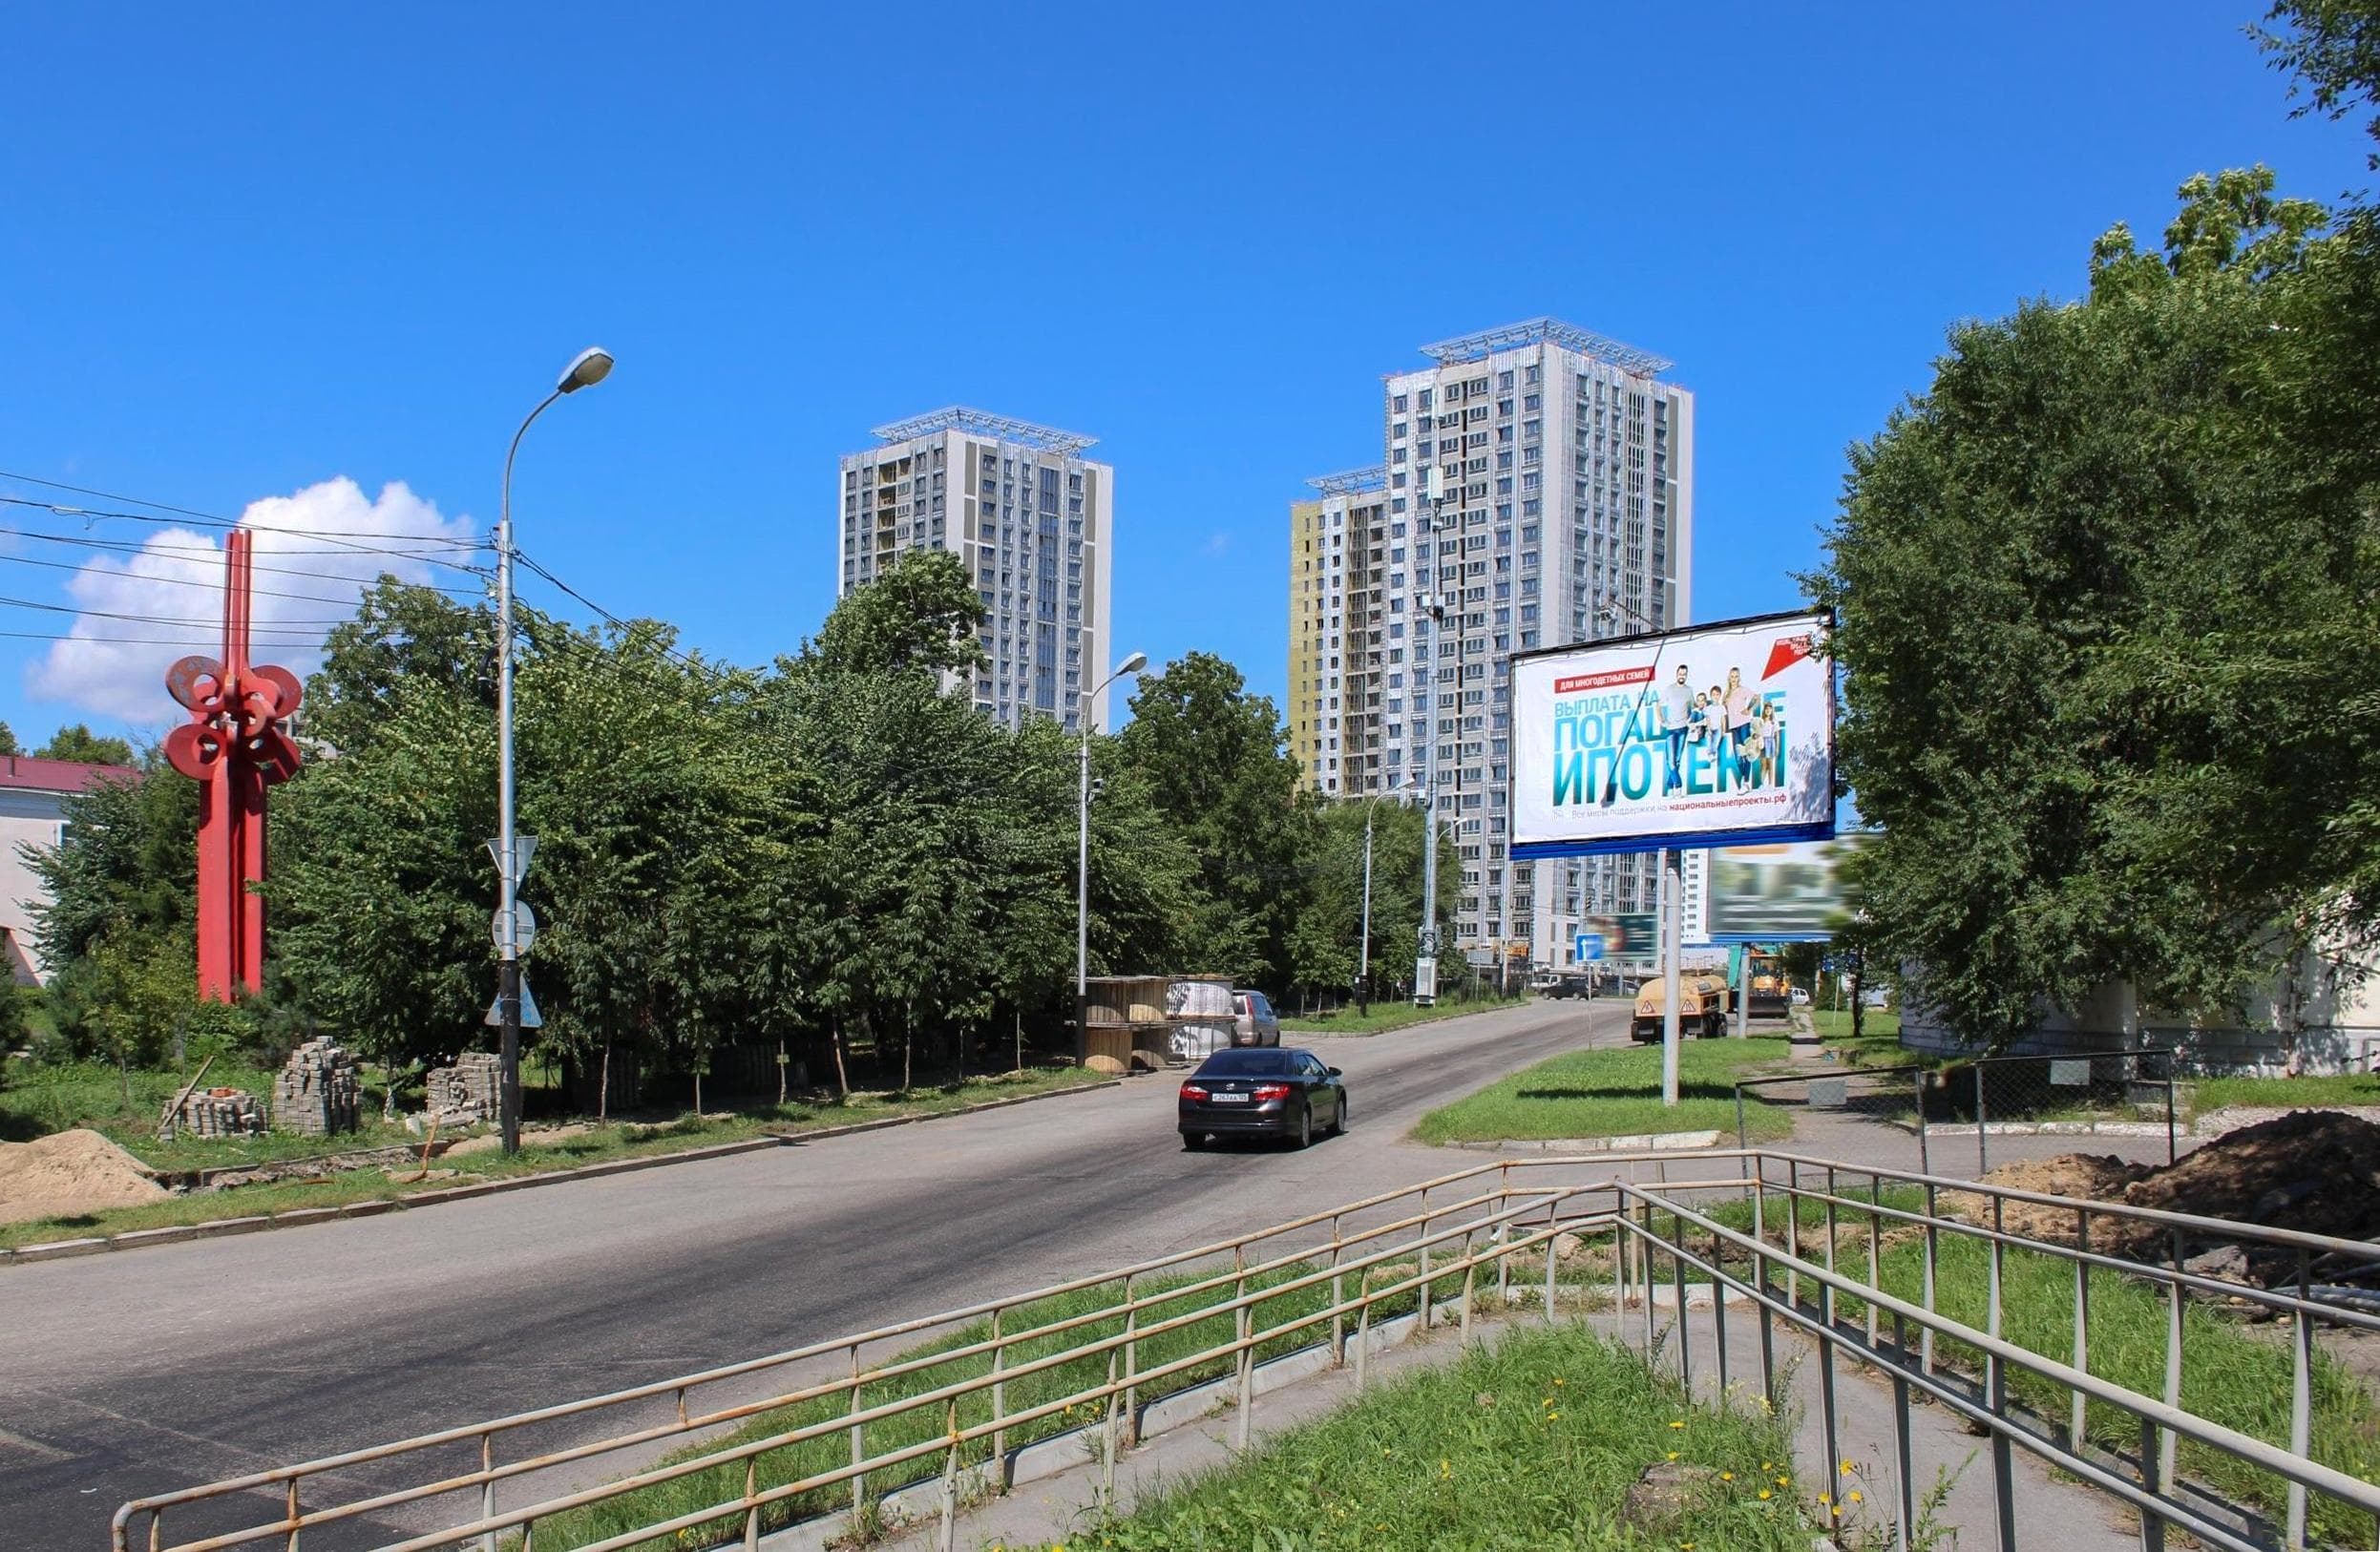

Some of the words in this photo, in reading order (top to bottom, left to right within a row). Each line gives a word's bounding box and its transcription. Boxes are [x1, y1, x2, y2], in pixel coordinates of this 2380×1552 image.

[1560, 681, 1574, 691] ДЛЯ
[1575, 673, 1625, 687] МНОГОДЕТНЫХ
[1626, 668, 1650, 681] СЕМЕЙ
[1554, 694, 1631, 718] ВЫПЛАТА
[1637, 689, 1659, 707] НА
[1669, 793, 1787, 811] национальныепроекты.рф
